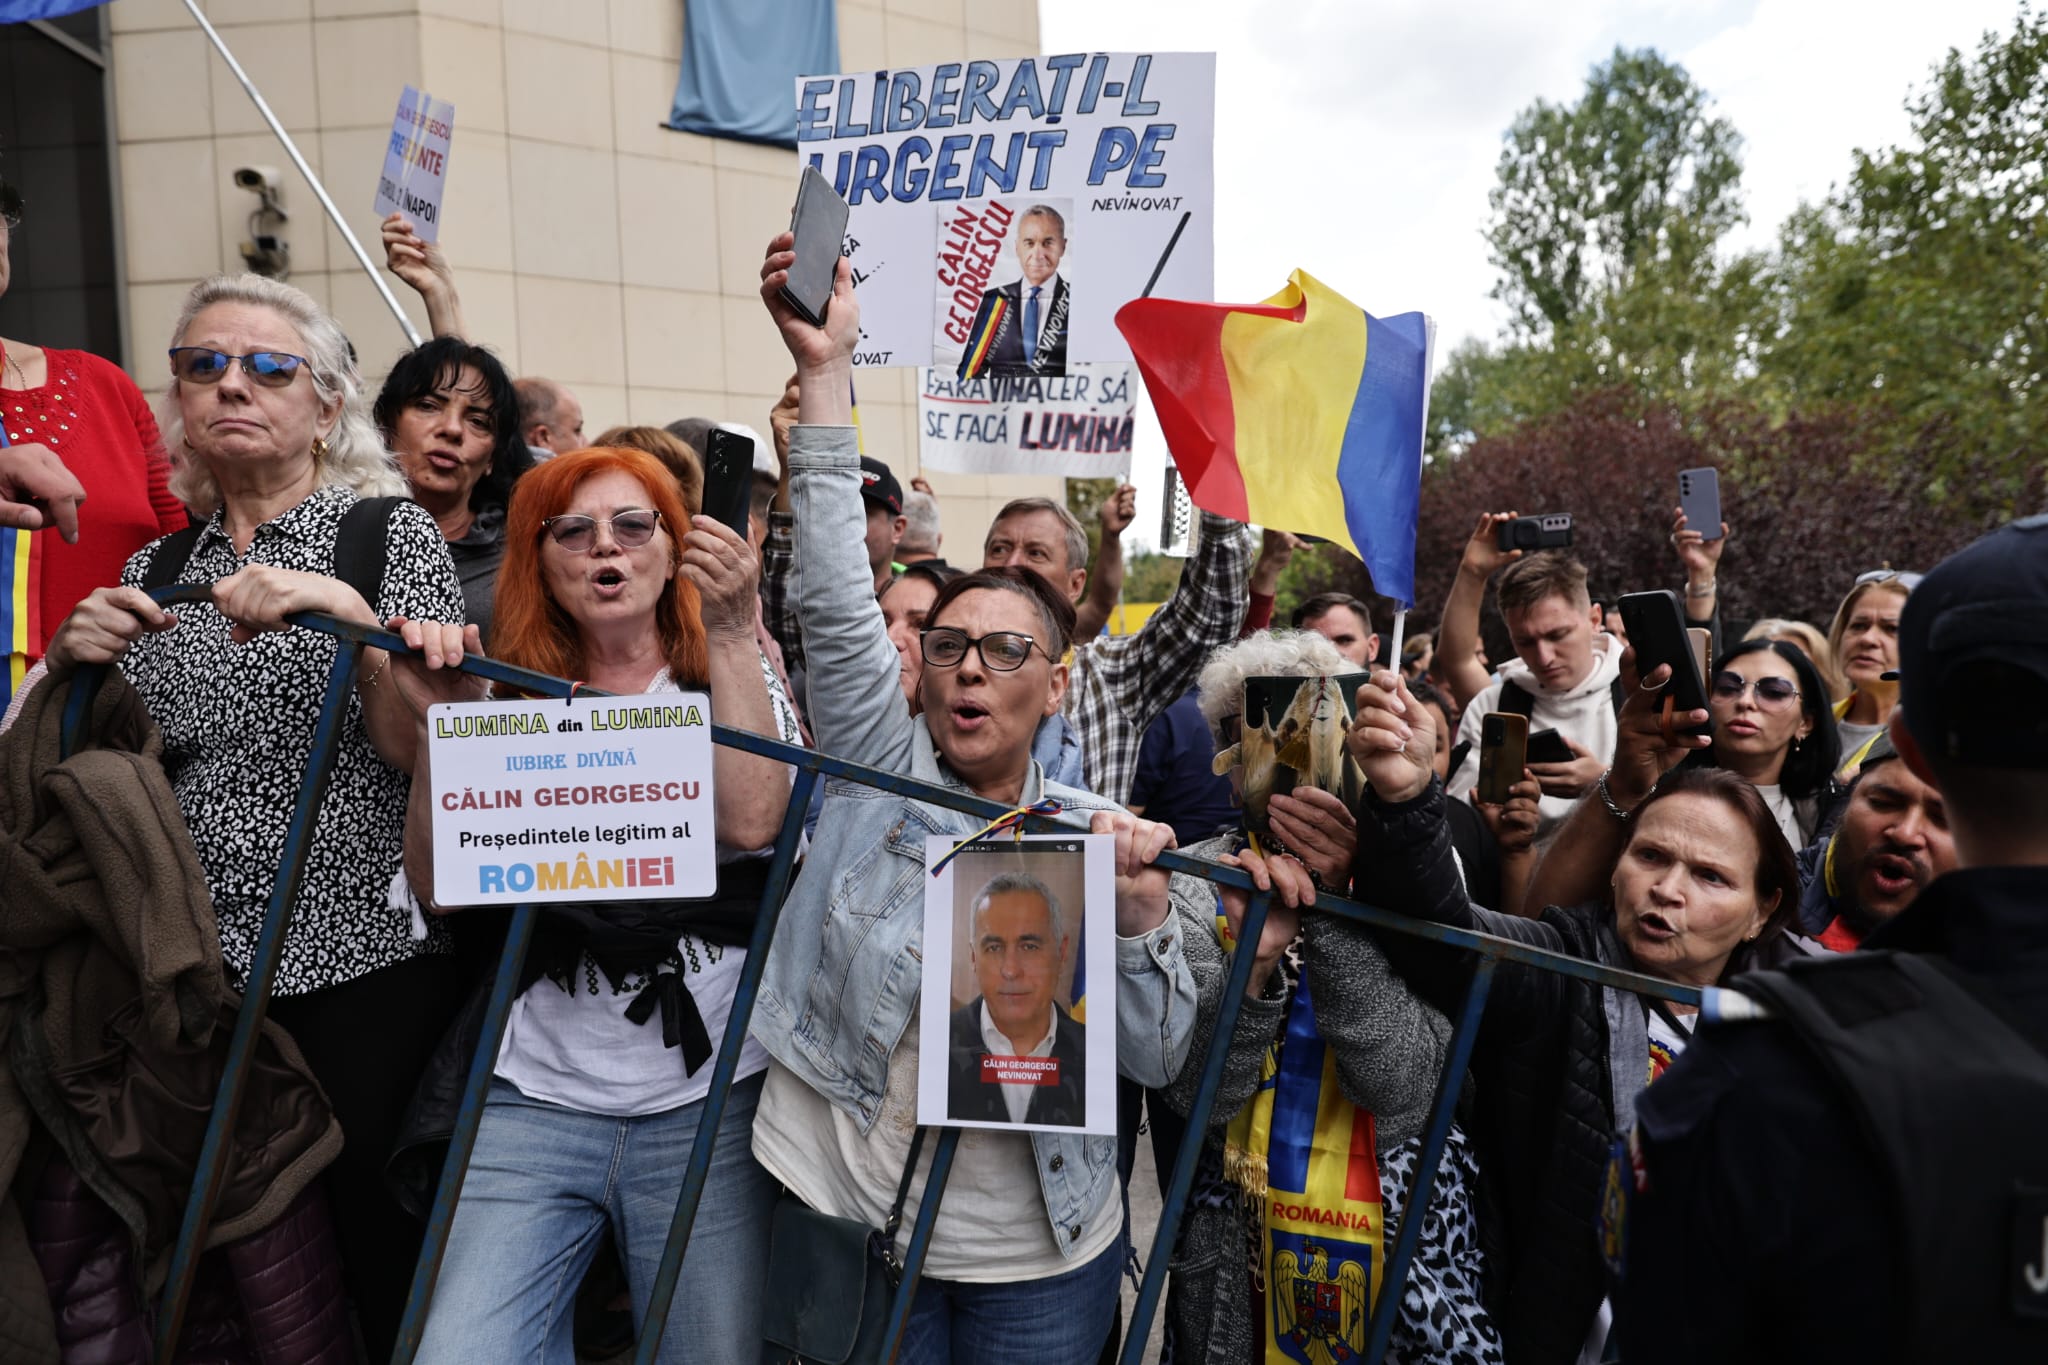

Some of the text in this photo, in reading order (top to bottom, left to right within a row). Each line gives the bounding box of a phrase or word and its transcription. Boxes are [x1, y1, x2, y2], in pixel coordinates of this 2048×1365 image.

[809, 124, 1177, 206] URGENT PE
[944, 200, 1015, 345] GEORGESCU
[926, 410, 950, 440] SE
[557, 719, 583, 733] din
[505, 747, 637, 772] IUBIRE DIVINĂ
[441, 781, 700, 811] CĂLIN GEORGESCU
[459, 822, 692, 851] Președintele legitim al
[997, 1071, 1043, 1081] NEVINOVAT
[1009, 1061, 1057, 1071] GEORGESCU
[1272, 1201, 1371, 1231] ROMANIA
